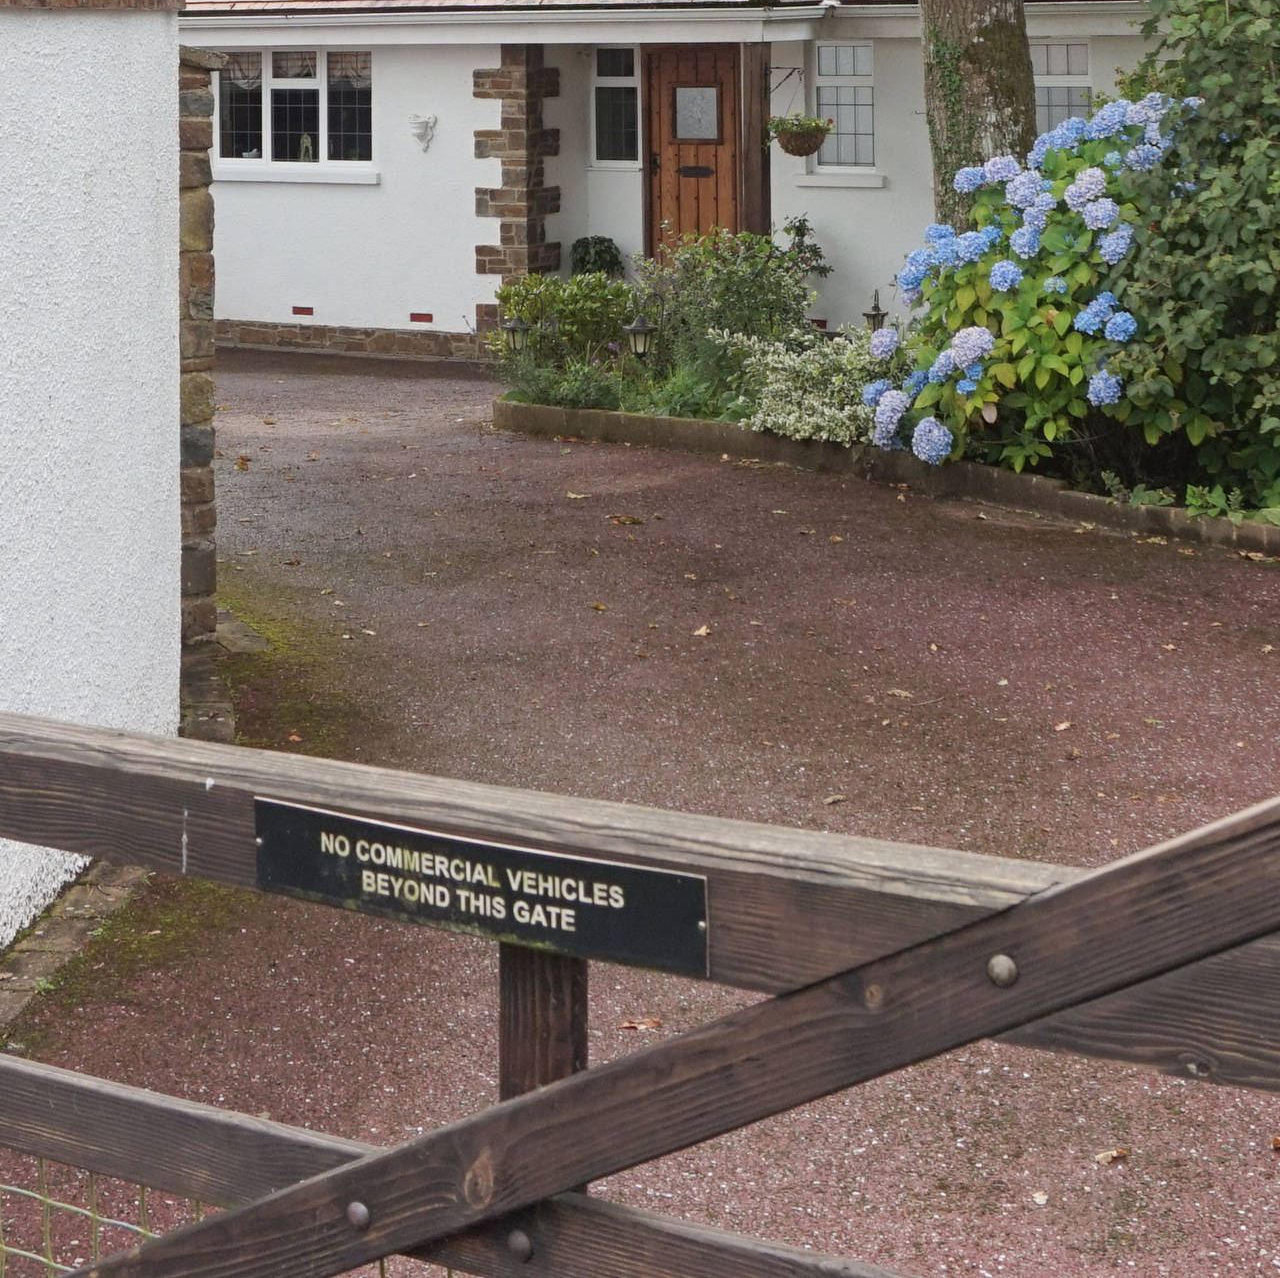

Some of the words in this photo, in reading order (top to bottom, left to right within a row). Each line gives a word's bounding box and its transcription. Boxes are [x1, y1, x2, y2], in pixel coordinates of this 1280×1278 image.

[320, 831, 350, 857] NO
[355, 840, 501, 888] COMMERCIAL
[506, 868, 625, 909] VEHICLES
[361, 870, 451, 908] BEYOND
[455, 889, 507, 920] THIS
[512, 900, 576, 932] GATE
